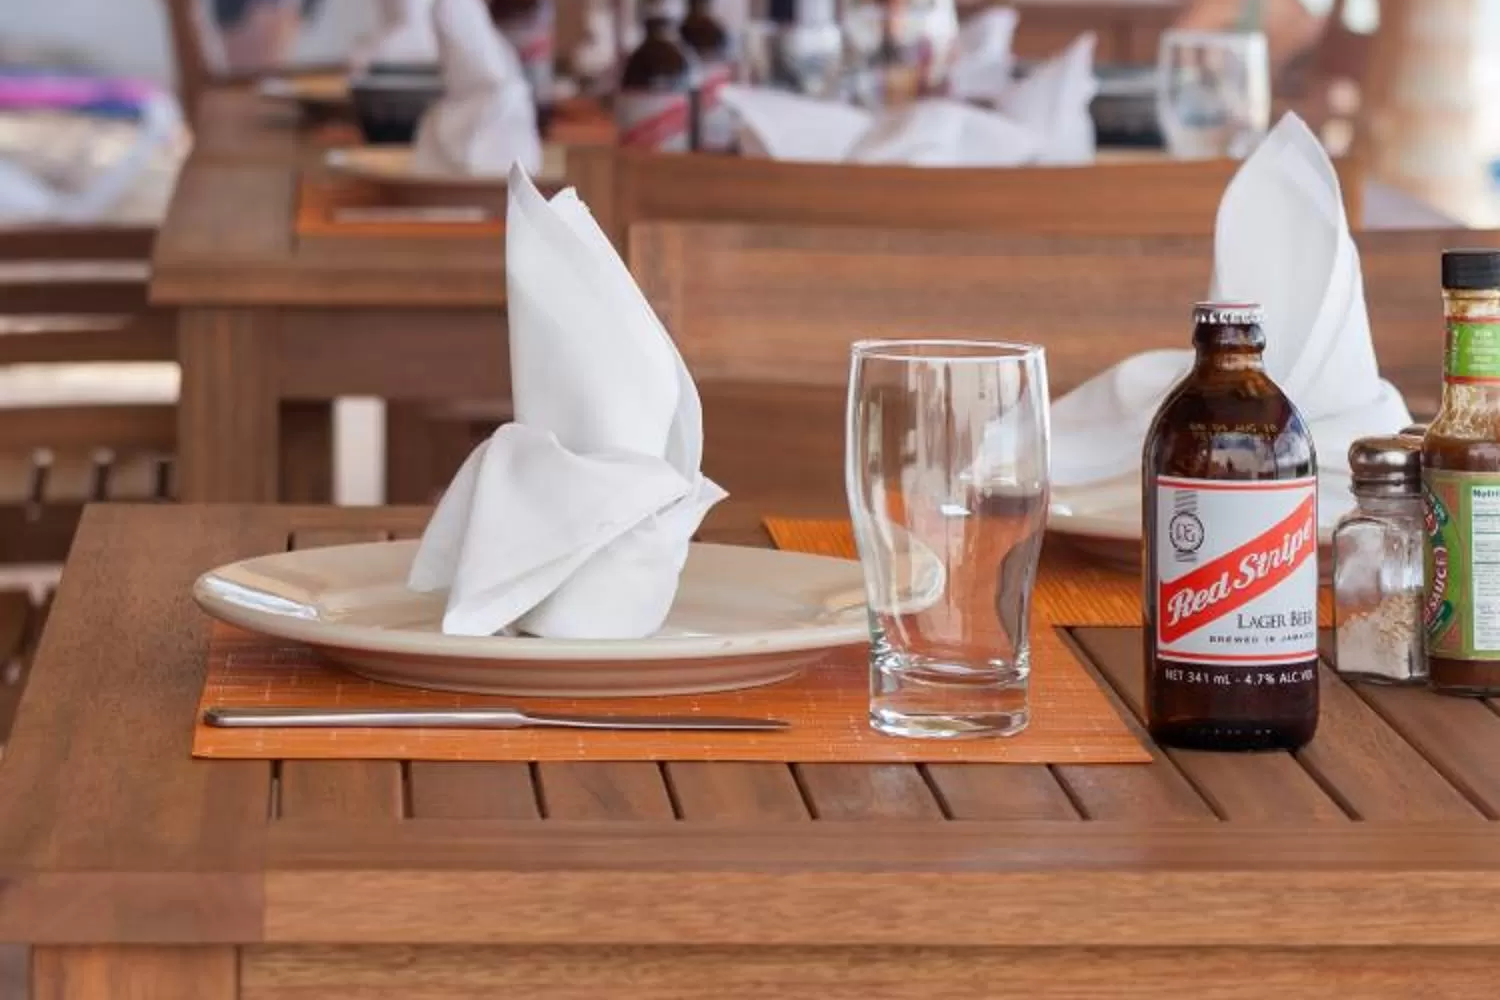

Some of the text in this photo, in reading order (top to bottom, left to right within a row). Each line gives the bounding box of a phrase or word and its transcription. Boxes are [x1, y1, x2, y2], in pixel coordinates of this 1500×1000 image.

[1167, 516, 1312, 627] Red Stripe
[1165, 668, 1184, 681] NET
[1187, 671, 1209, 684] 341
[1244, 673, 1275, 686] 4.7%
